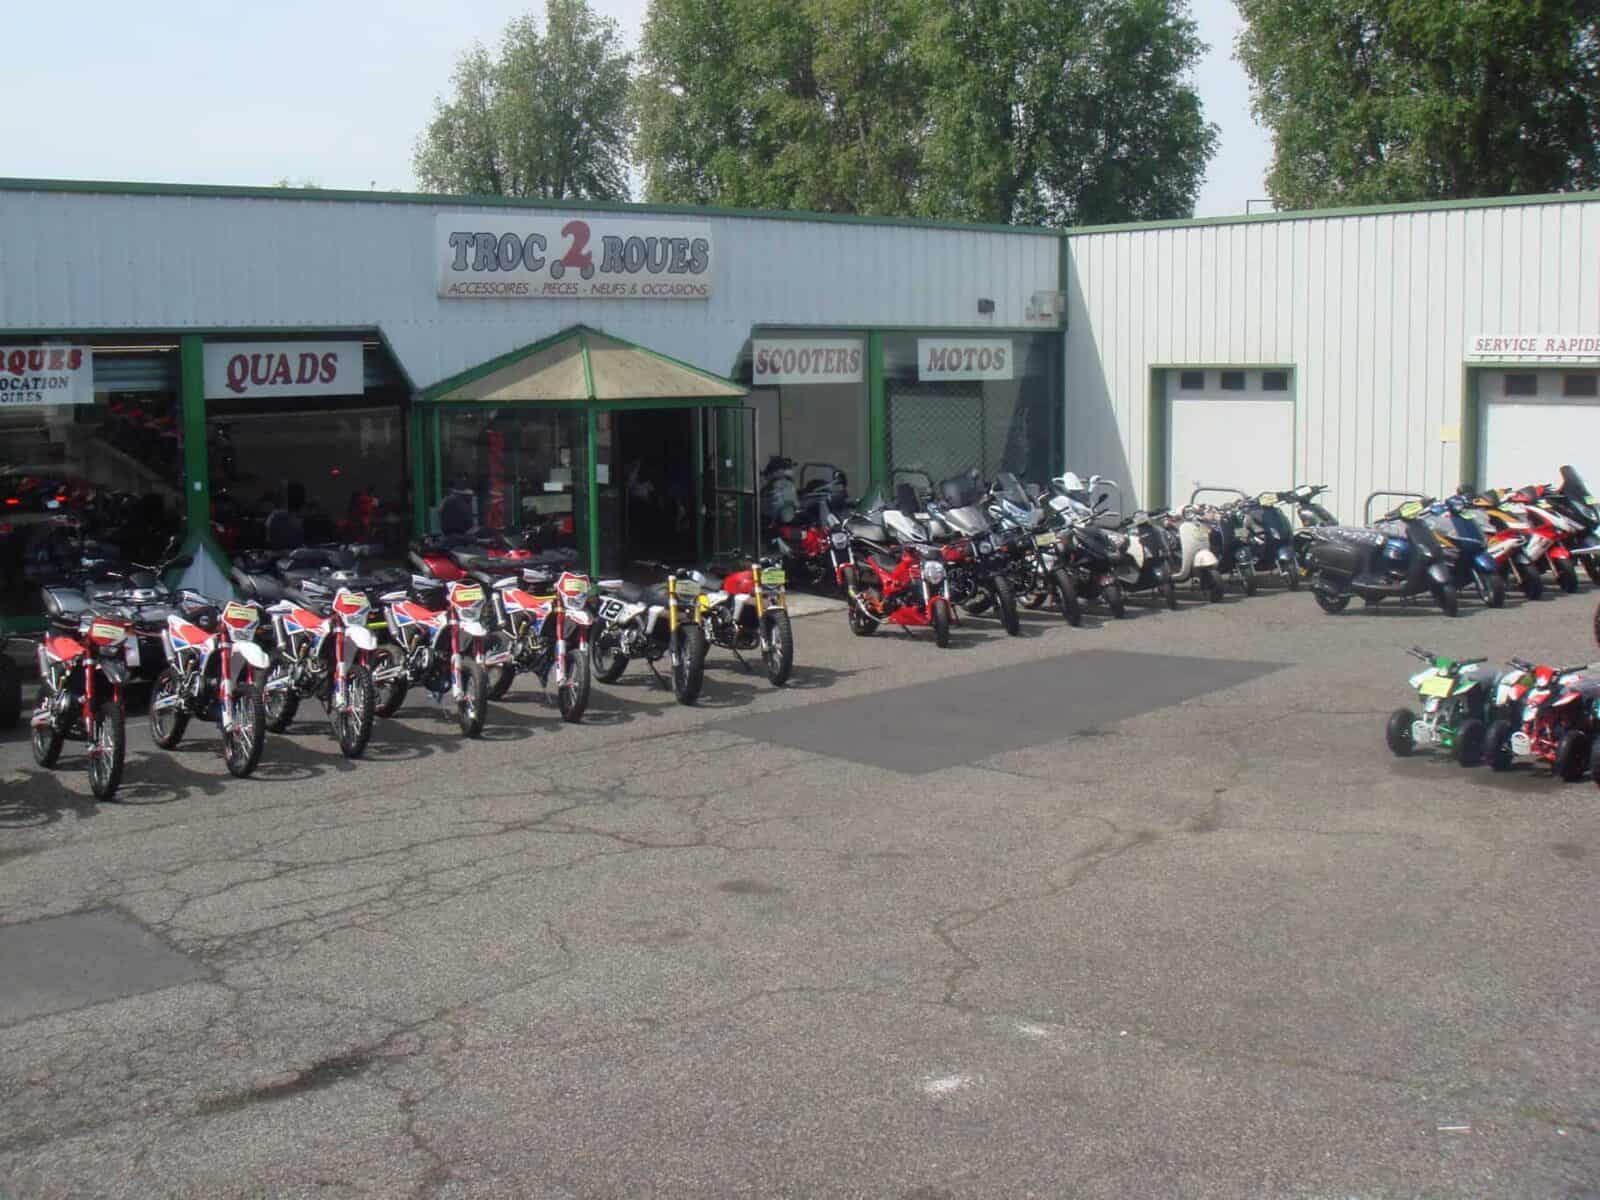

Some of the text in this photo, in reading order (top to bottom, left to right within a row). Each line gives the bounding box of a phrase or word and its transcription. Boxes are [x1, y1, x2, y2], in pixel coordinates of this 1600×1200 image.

[449, 220, 709, 274] TROC 2 ROUES
[448, 281, 529, 295] ACCESSOIRES
[592, 283, 626, 295] NEUFS
[642, 284, 706, 296] OCCASIONS
[1475, 338, 1537, 352] SERVICE
[226, 352, 338, 393] QUADS
[755, 347, 861, 375] SCOOTERS
[927, 347, 1005, 372] MOTOS
